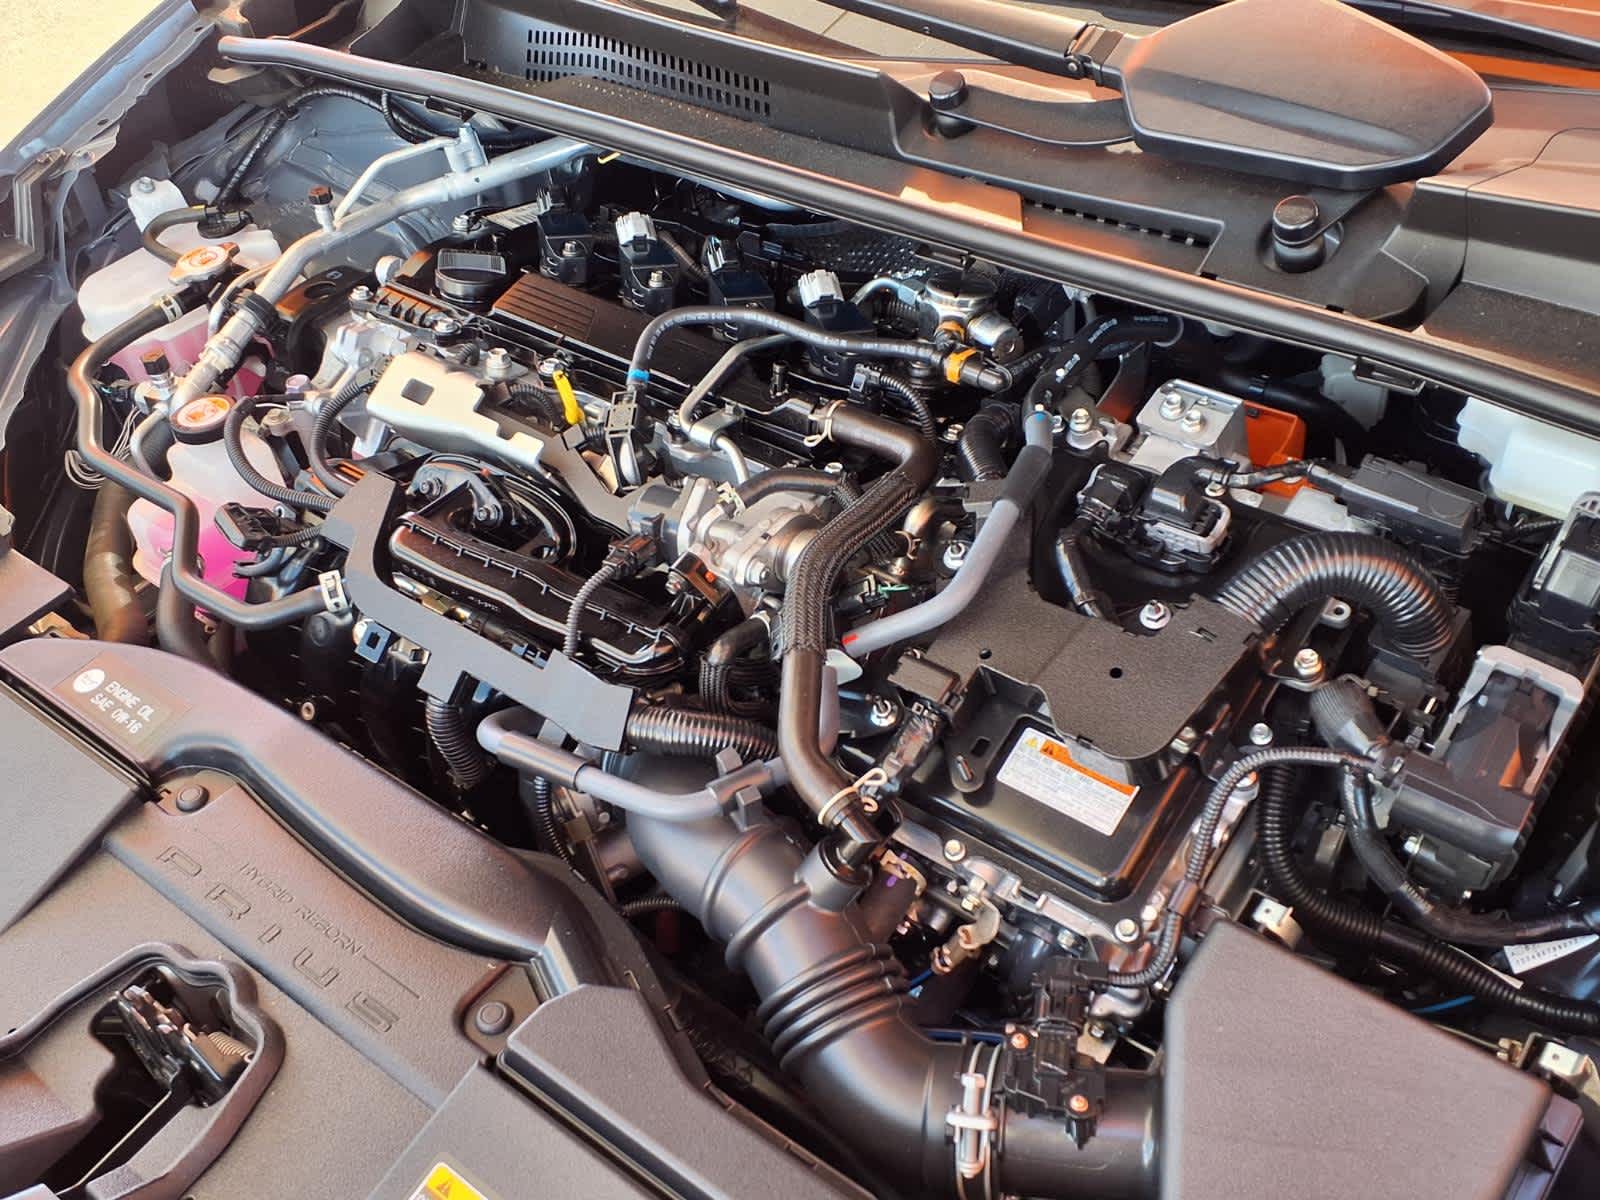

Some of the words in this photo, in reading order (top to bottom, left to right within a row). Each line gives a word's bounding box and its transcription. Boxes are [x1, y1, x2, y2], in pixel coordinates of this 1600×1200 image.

[90, 692, 115, 712] SAE
[104, 680, 141, 709] ENGINE
[137, 704, 155, 722] OIL
[155, 845, 400, 1033] PRIUS
[239, 863, 294, 903] HYBRID
[295, 905, 364, 954] REBORN
